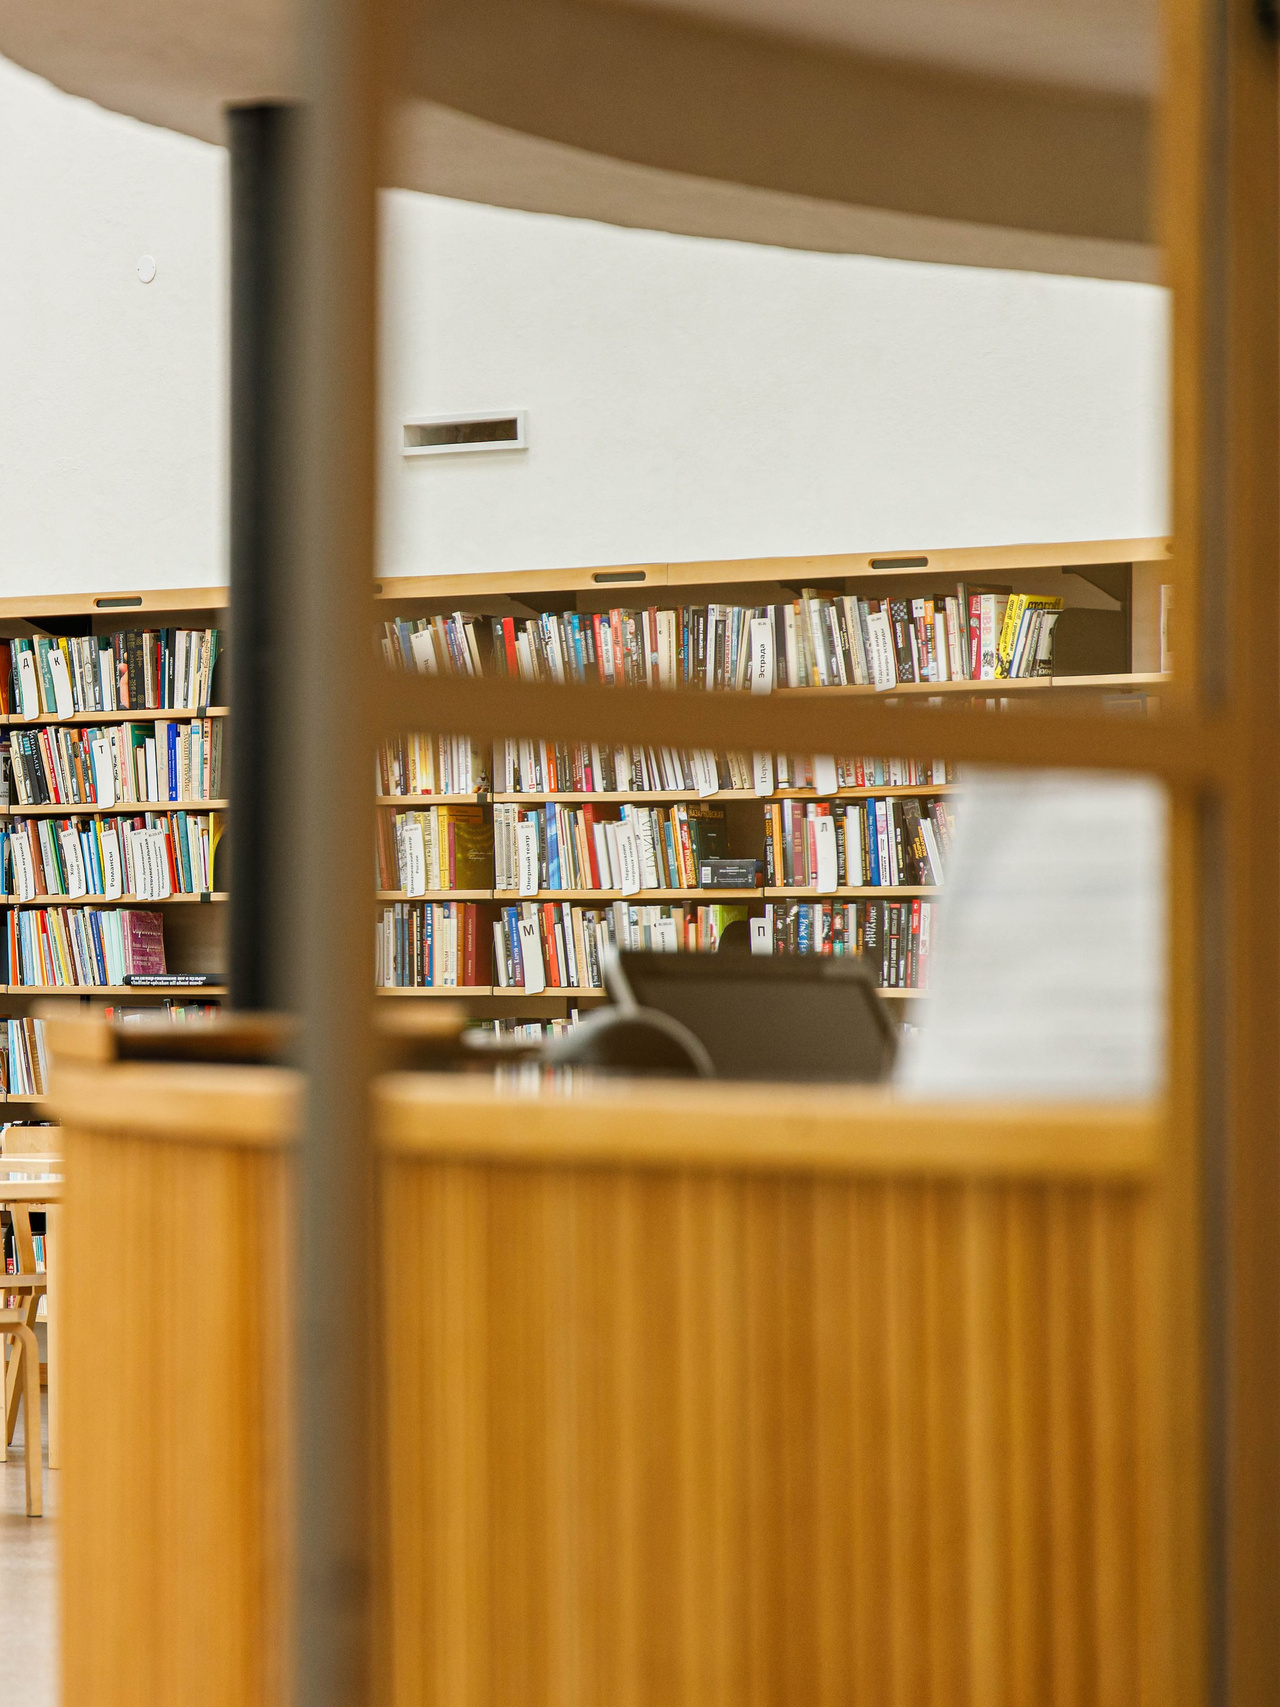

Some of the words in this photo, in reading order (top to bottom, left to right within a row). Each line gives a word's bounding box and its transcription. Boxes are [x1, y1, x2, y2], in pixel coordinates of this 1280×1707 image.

[22, 658, 30, 670] Д
[53, 657, 60, 667] К
[758, 643, 766, 679] Эстрада
[883, 654, 891, 677] жанры
[29, 733, 40, 769] ПУЧЧИНИ
[98, 745, 104, 755] Т
[760, 755, 768, 784] Персо
[836, 828, 844, 846] НЕБЕСА
[144, 838, 154, 898] Инструментальная
[621, 844, 630, 881] Персоналии
[523, 924, 535, 937] М
[758, 925, 766, 937] П
